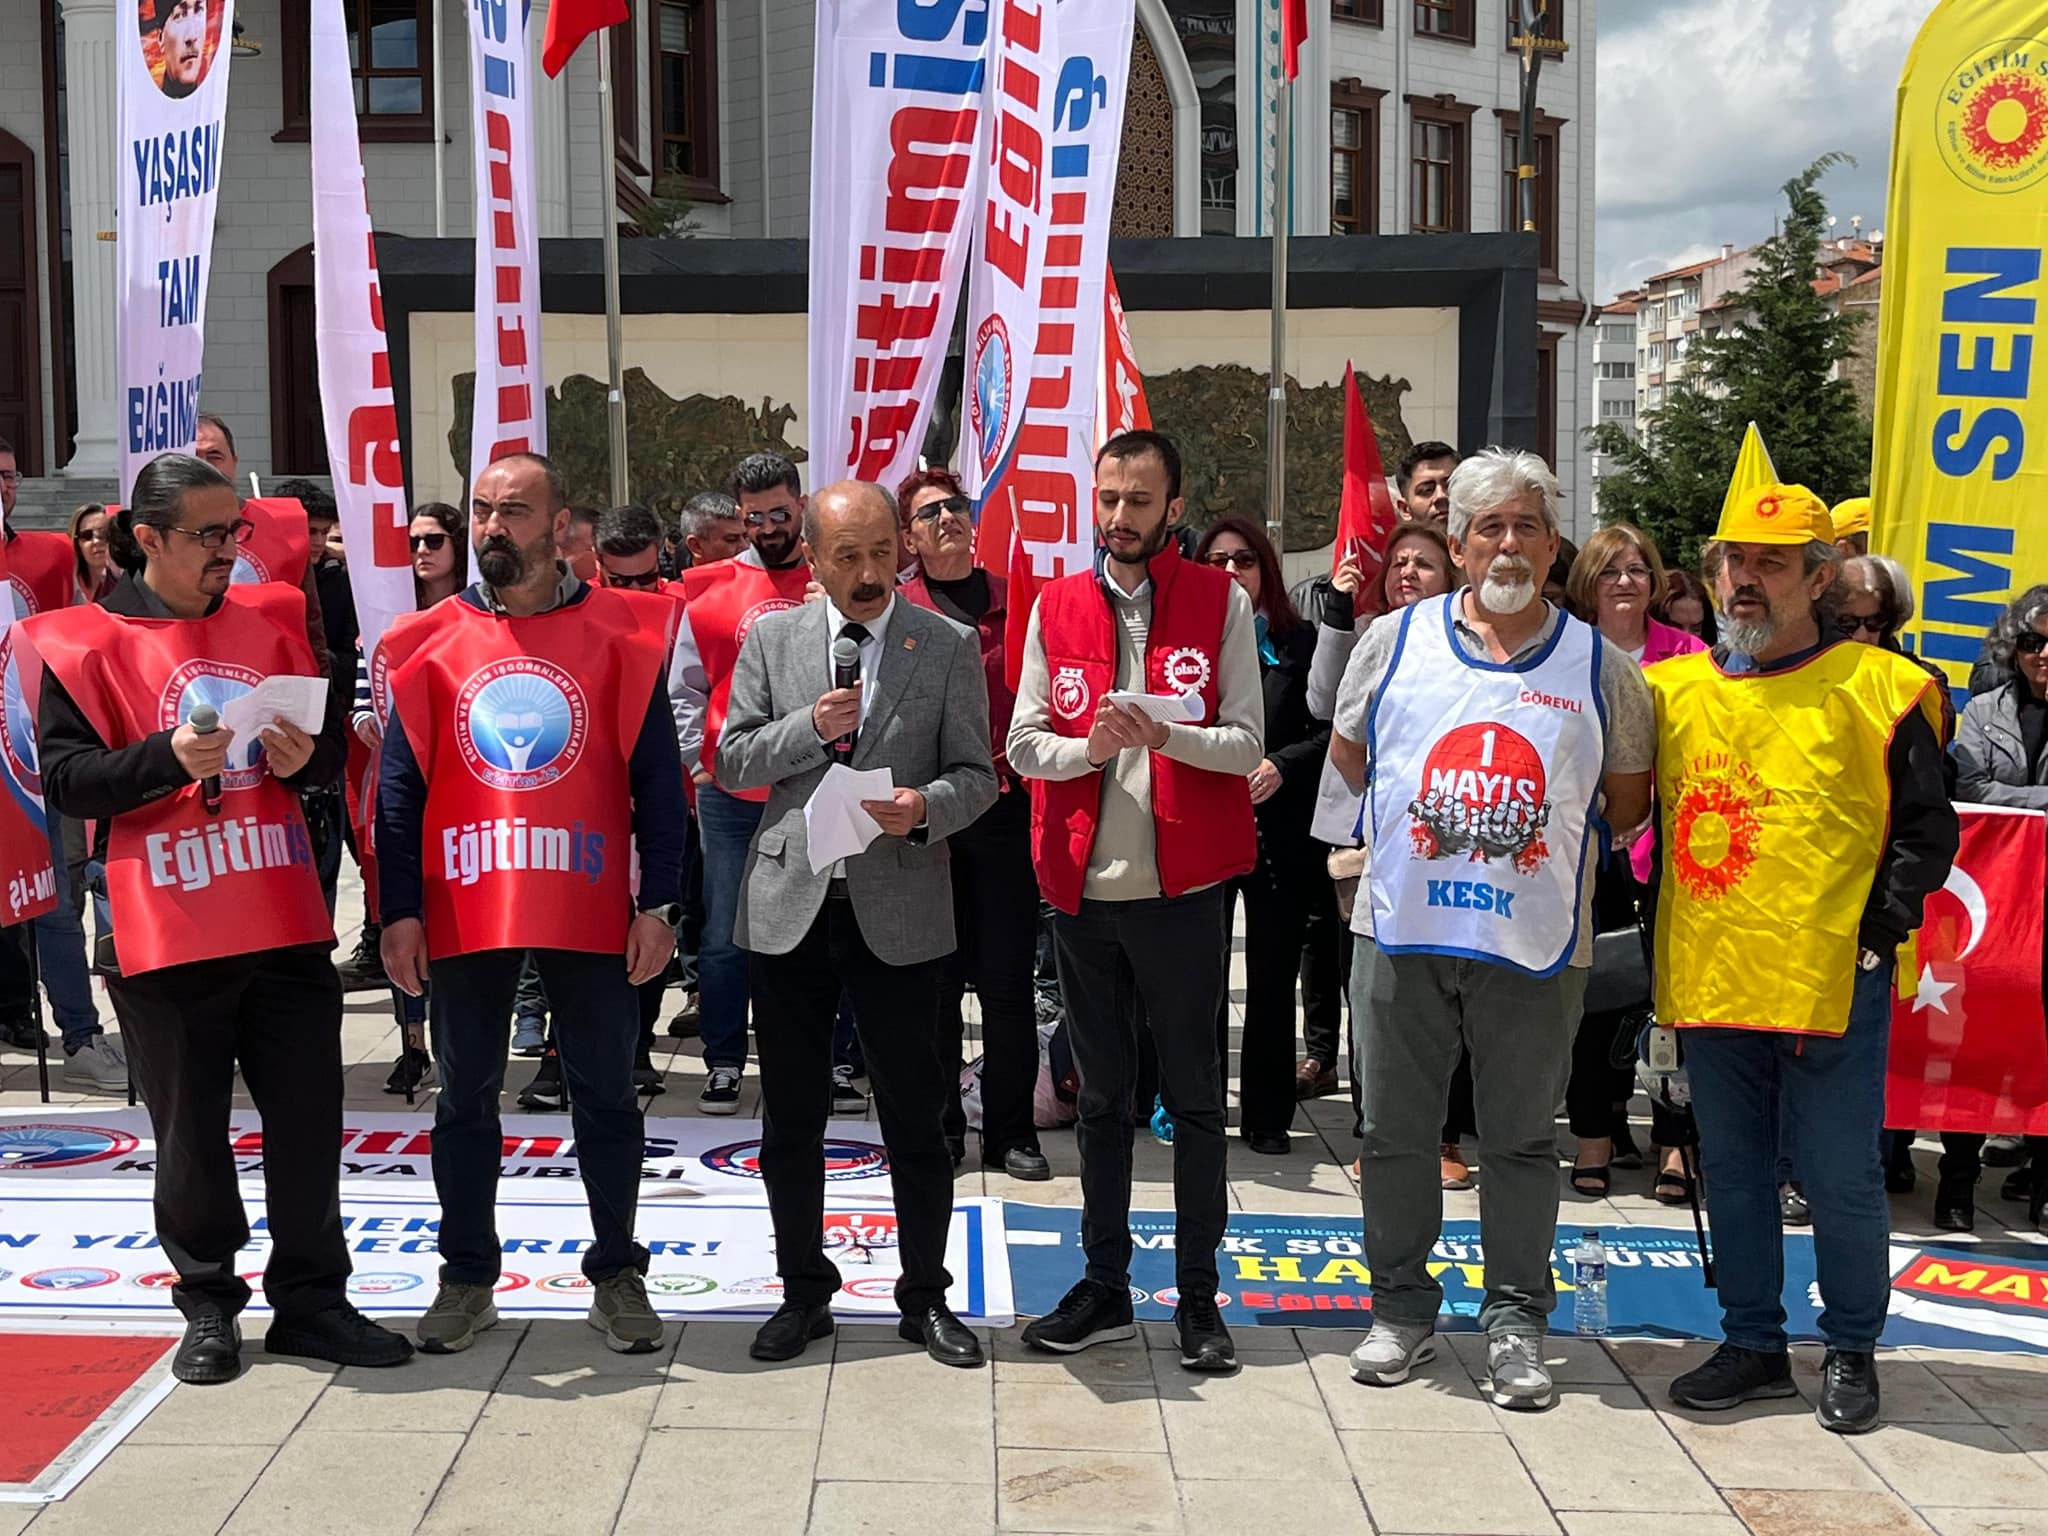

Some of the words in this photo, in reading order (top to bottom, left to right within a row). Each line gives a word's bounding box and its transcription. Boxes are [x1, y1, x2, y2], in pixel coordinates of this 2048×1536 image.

[1947, 50, 2029, 105] EĞİTİM
[158, 254, 201, 328] TAM
[1932, 247, 2042, 482] SEN
[166, 673, 187, 709] BİLİM
[186, 663, 259, 687] İŞGÖRENLER
[1520, 690, 1584, 714] GÖREVLİ
[459, 703, 468, 718] VE
[464, 672, 492, 700] BİLİM
[494, 661, 574, 693] İŞGÖRENLERİ
[568, 694, 584, 761] SENDİKASI
[1481, 730, 1496, 768] 1
[1429, 768, 1536, 810] MAYIS
[442, 817, 606, 886] Eğitimiş
[1427, 879, 1515, 920] KESK
[1913, 1262, 2048, 1304] MA
